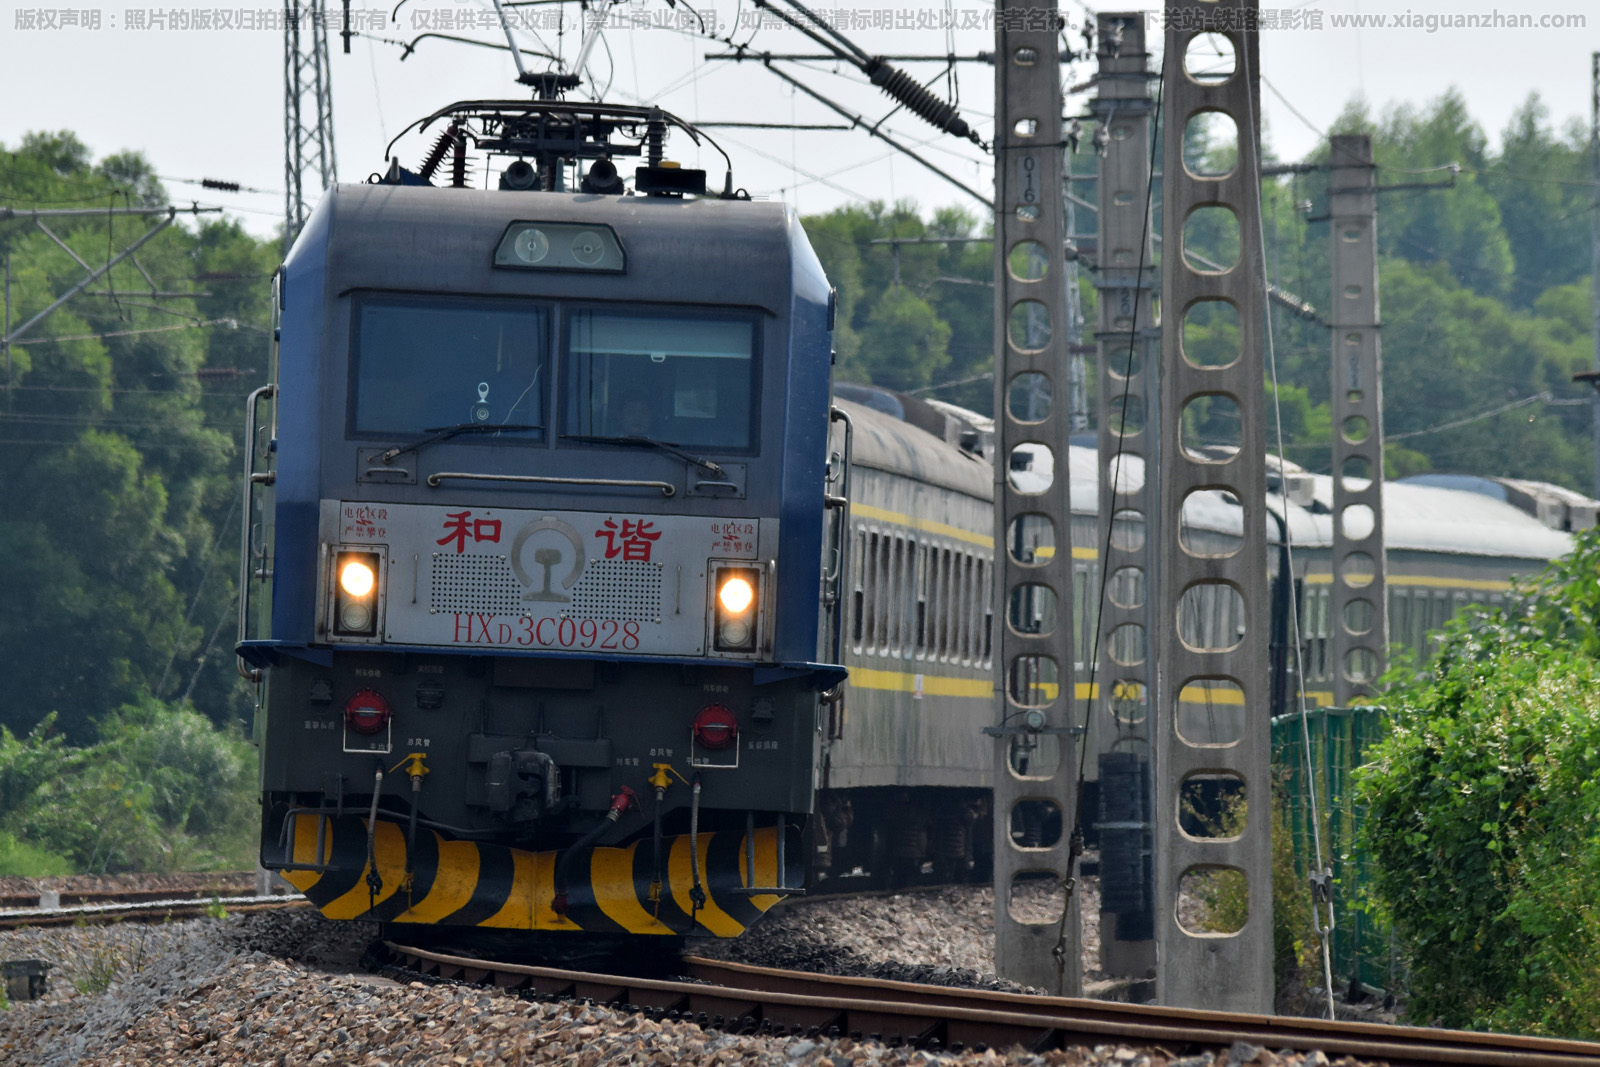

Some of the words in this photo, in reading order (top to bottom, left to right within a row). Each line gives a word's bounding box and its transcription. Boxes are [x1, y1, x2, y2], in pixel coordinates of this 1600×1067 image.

[1023, 156, 1036, 203] 016
[344, 506, 388, 521] 电化区段
[711, 523, 754, 535] 电化区段
[437, 510, 502, 553] 和
[596, 517, 662, 562] 谐
